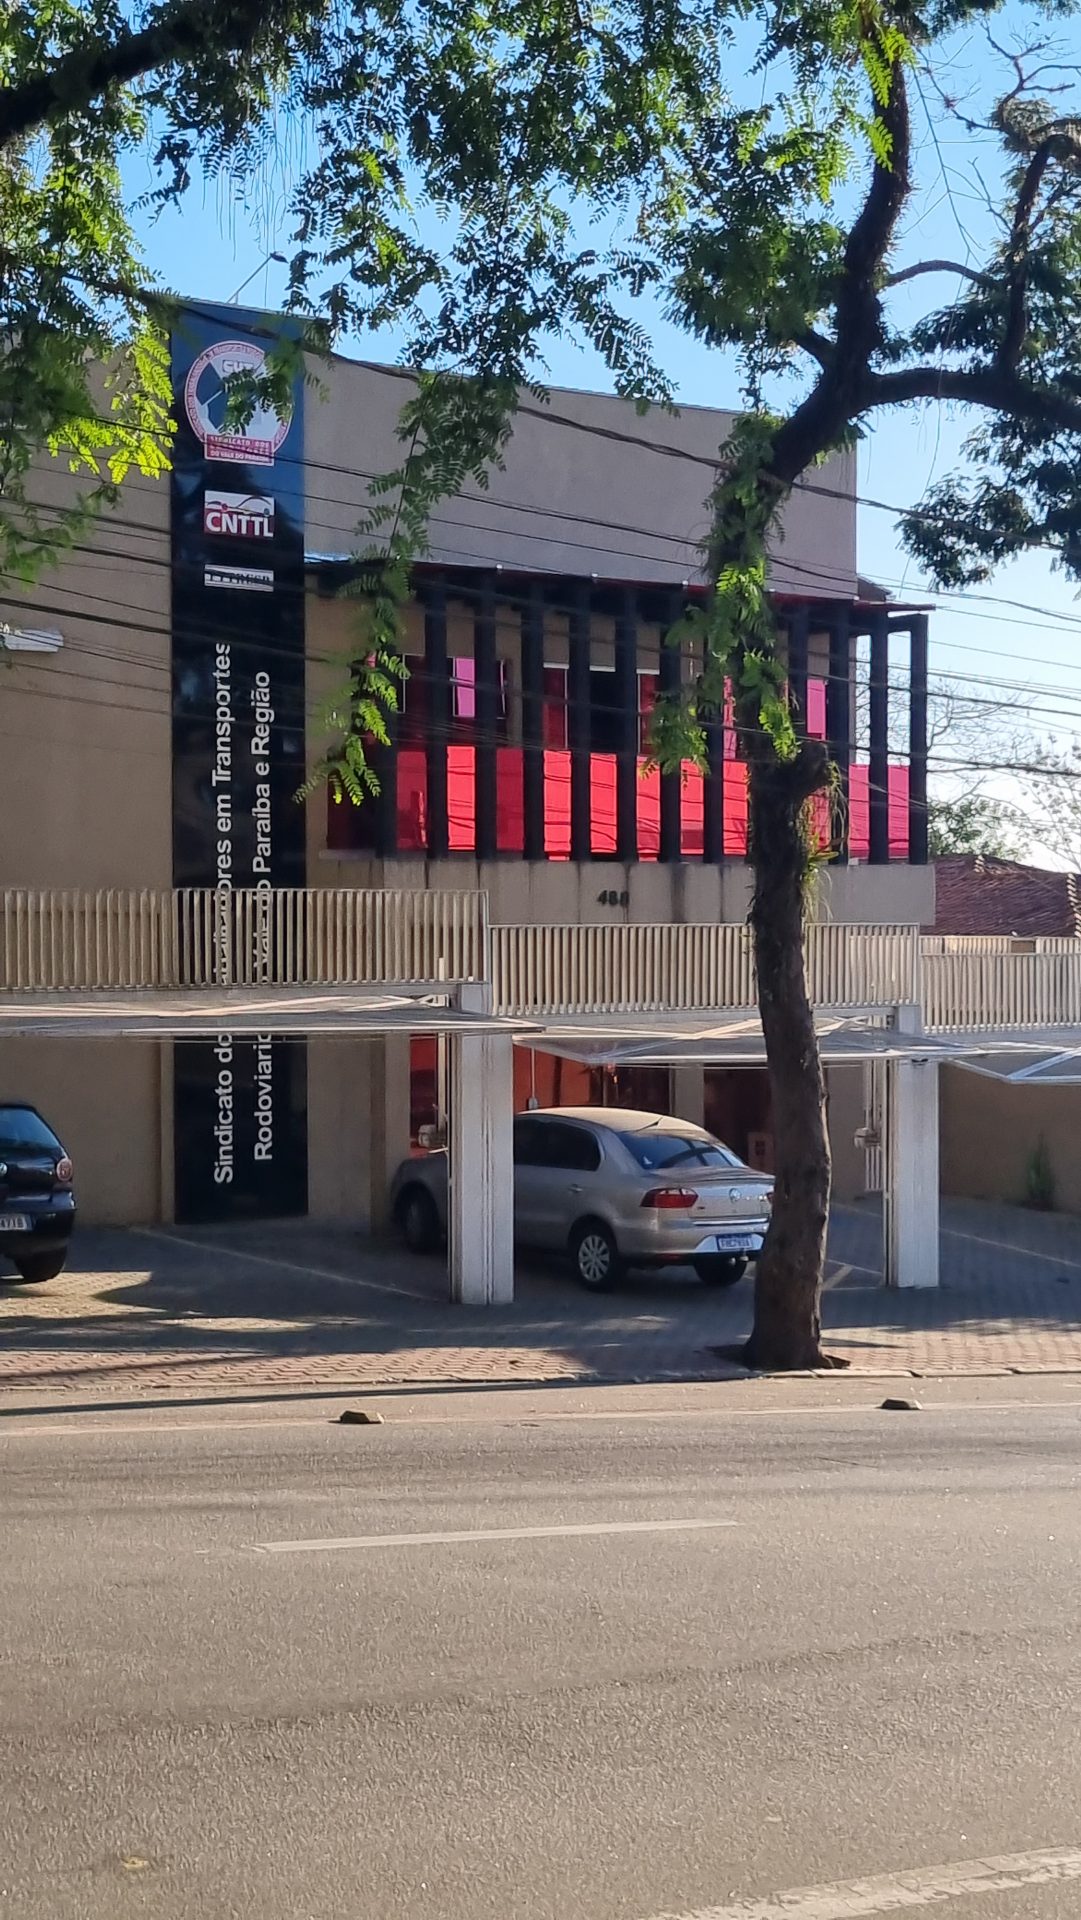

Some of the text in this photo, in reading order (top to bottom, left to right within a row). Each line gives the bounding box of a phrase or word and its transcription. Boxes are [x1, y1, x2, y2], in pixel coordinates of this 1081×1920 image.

[206, 511, 274, 537] CNTTL
[212, 643, 236, 787] Transportes
[250, 671, 275, 755] Região
[255, 761, 270, 776] e
[216, 793, 232, 832] em
[213, 1069, 233, 1185] Sindicato
